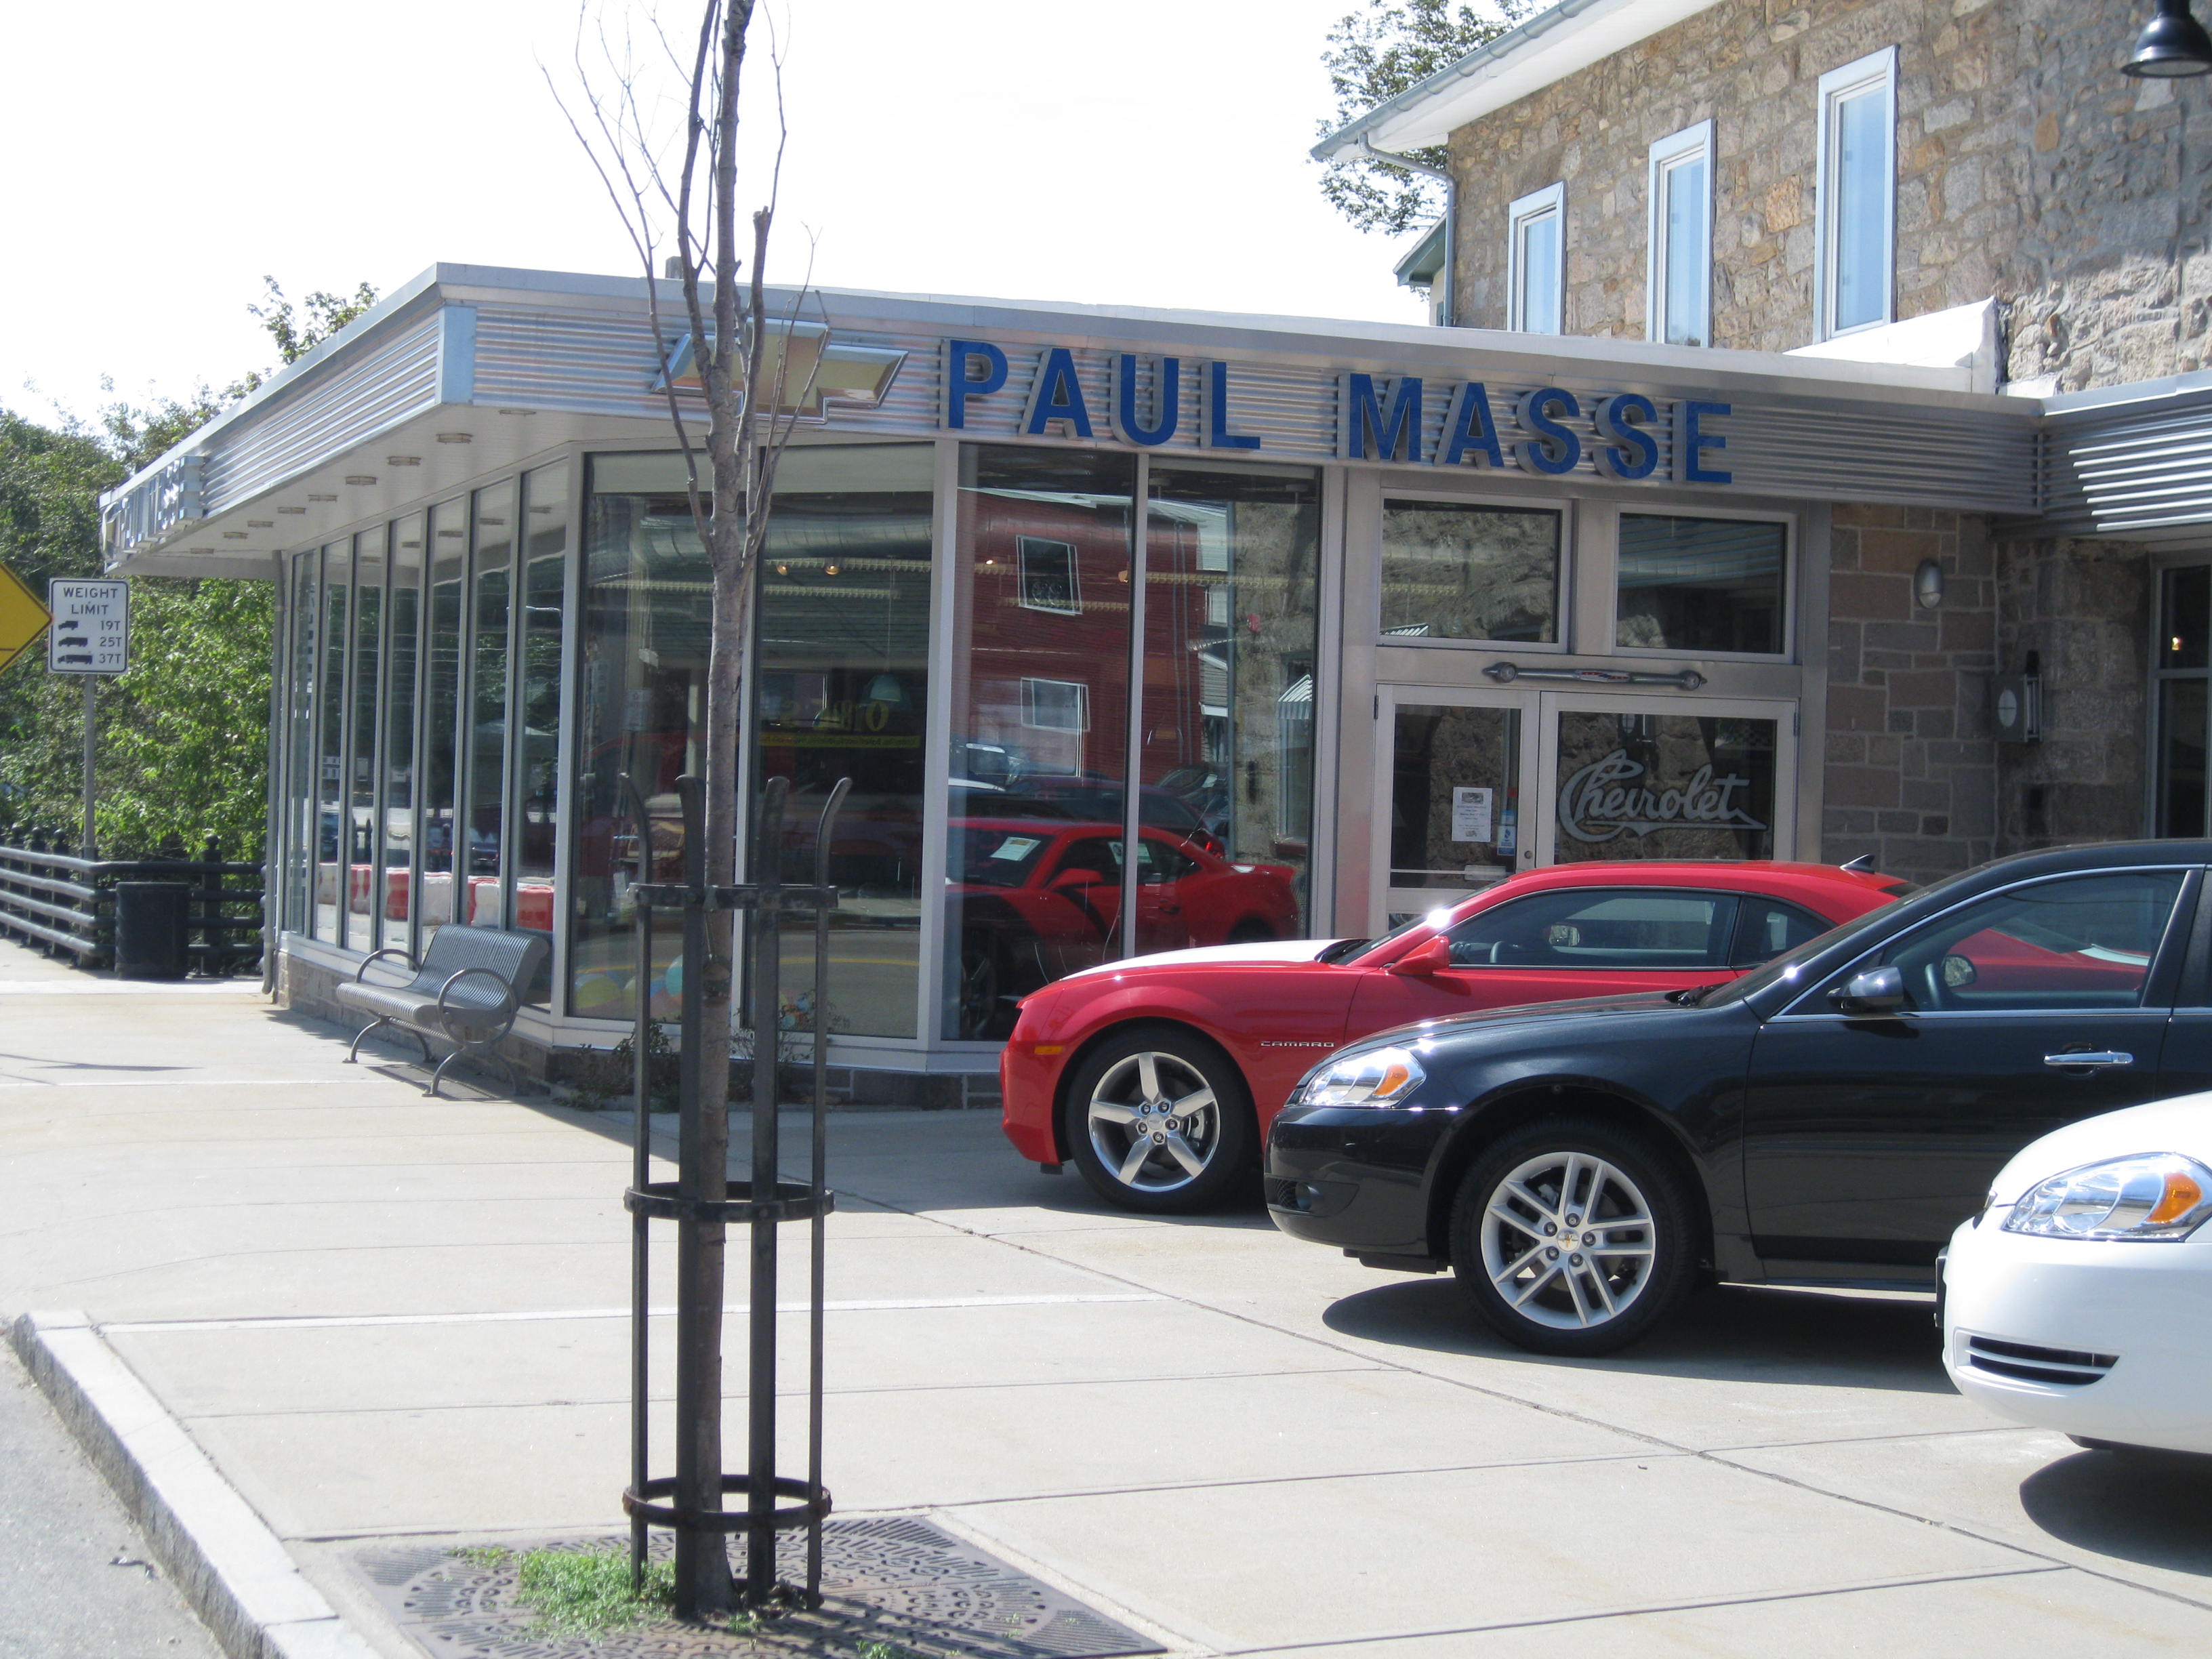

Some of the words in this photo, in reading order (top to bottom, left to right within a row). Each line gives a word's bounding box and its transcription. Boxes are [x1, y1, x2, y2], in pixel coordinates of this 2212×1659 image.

[942, 339, 1261, 450] PAUL
[1340, 373, 1732, 484] MASSE
[63, 587, 119, 599] WEIGHT
[70, 604, 109, 615] LIMIT
[100, 619, 121, 632] 19T
[99, 636, 122, 648] 25T
[98, 653, 122, 664] 37T
[1559, 748, 1767, 842] Chevrolet
